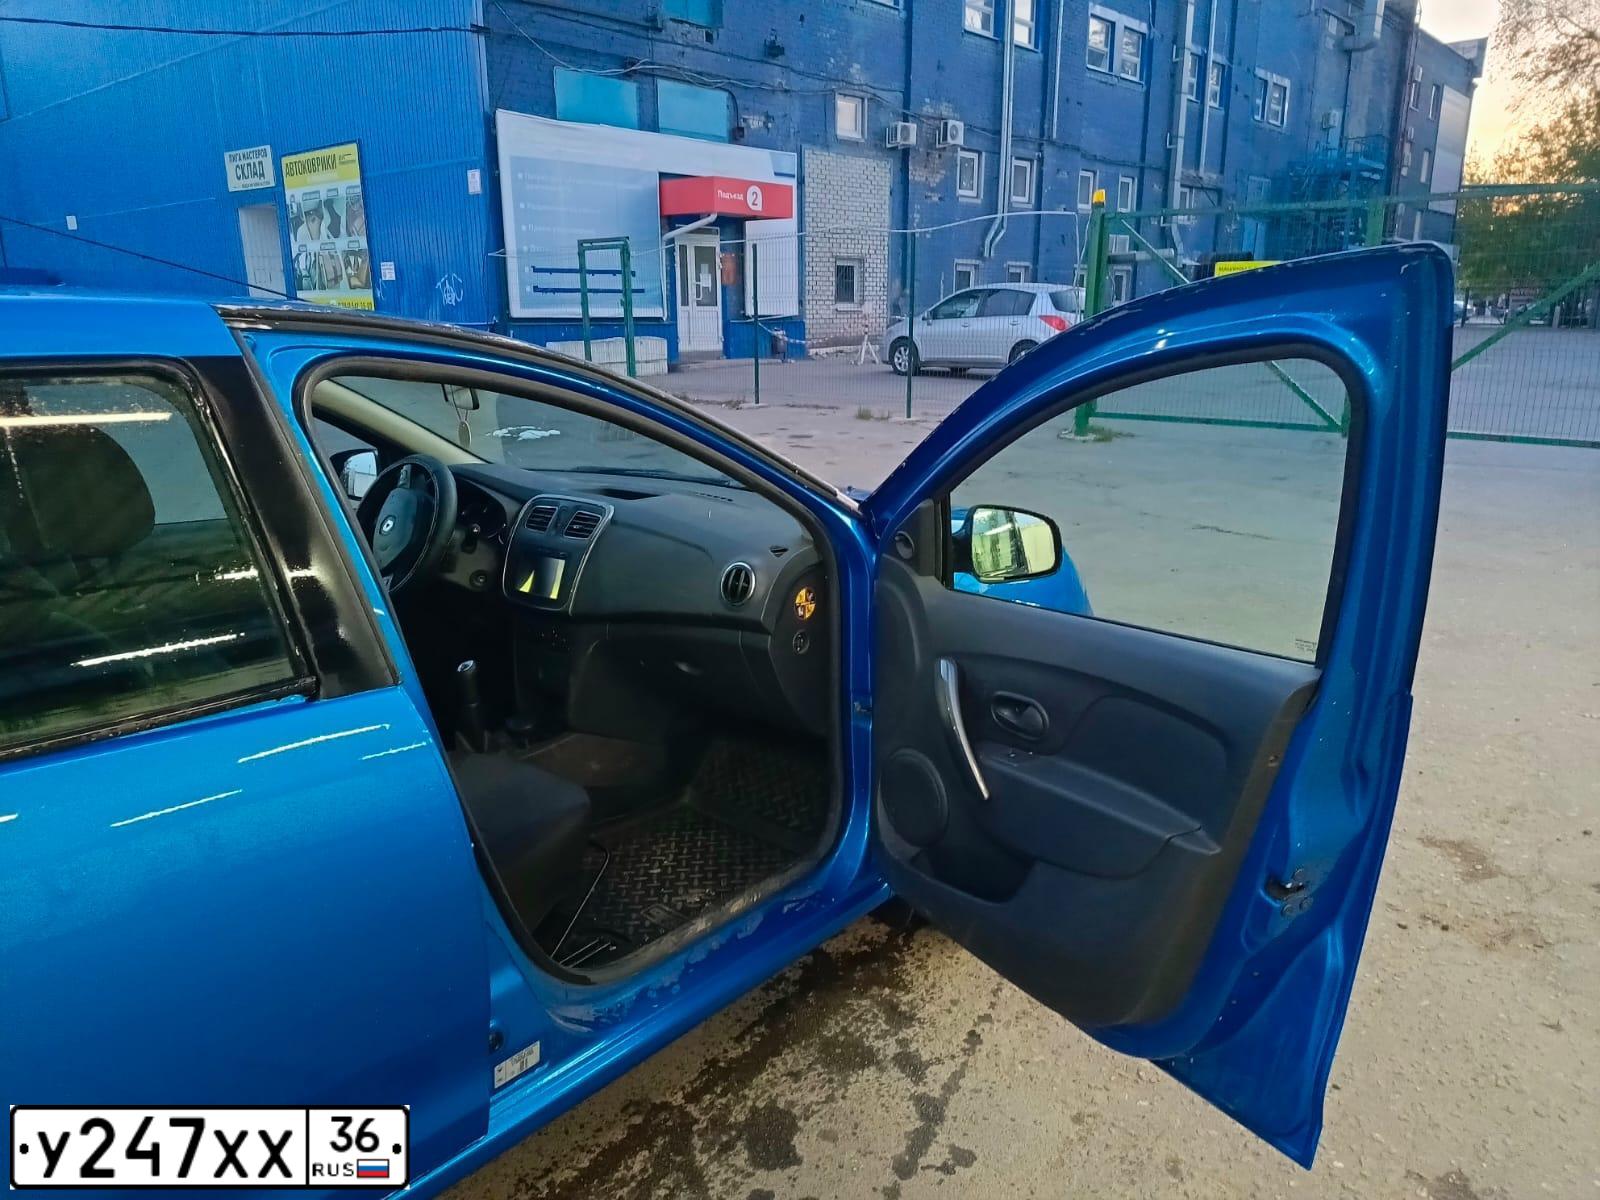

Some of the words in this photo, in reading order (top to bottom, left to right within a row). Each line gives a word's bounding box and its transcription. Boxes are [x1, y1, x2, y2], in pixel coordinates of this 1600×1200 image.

[235, 160, 266, 180] СКЛАД
[285, 154, 337, 178] АВТОКОВРИКИ
[751, 191, 758, 206] 2
